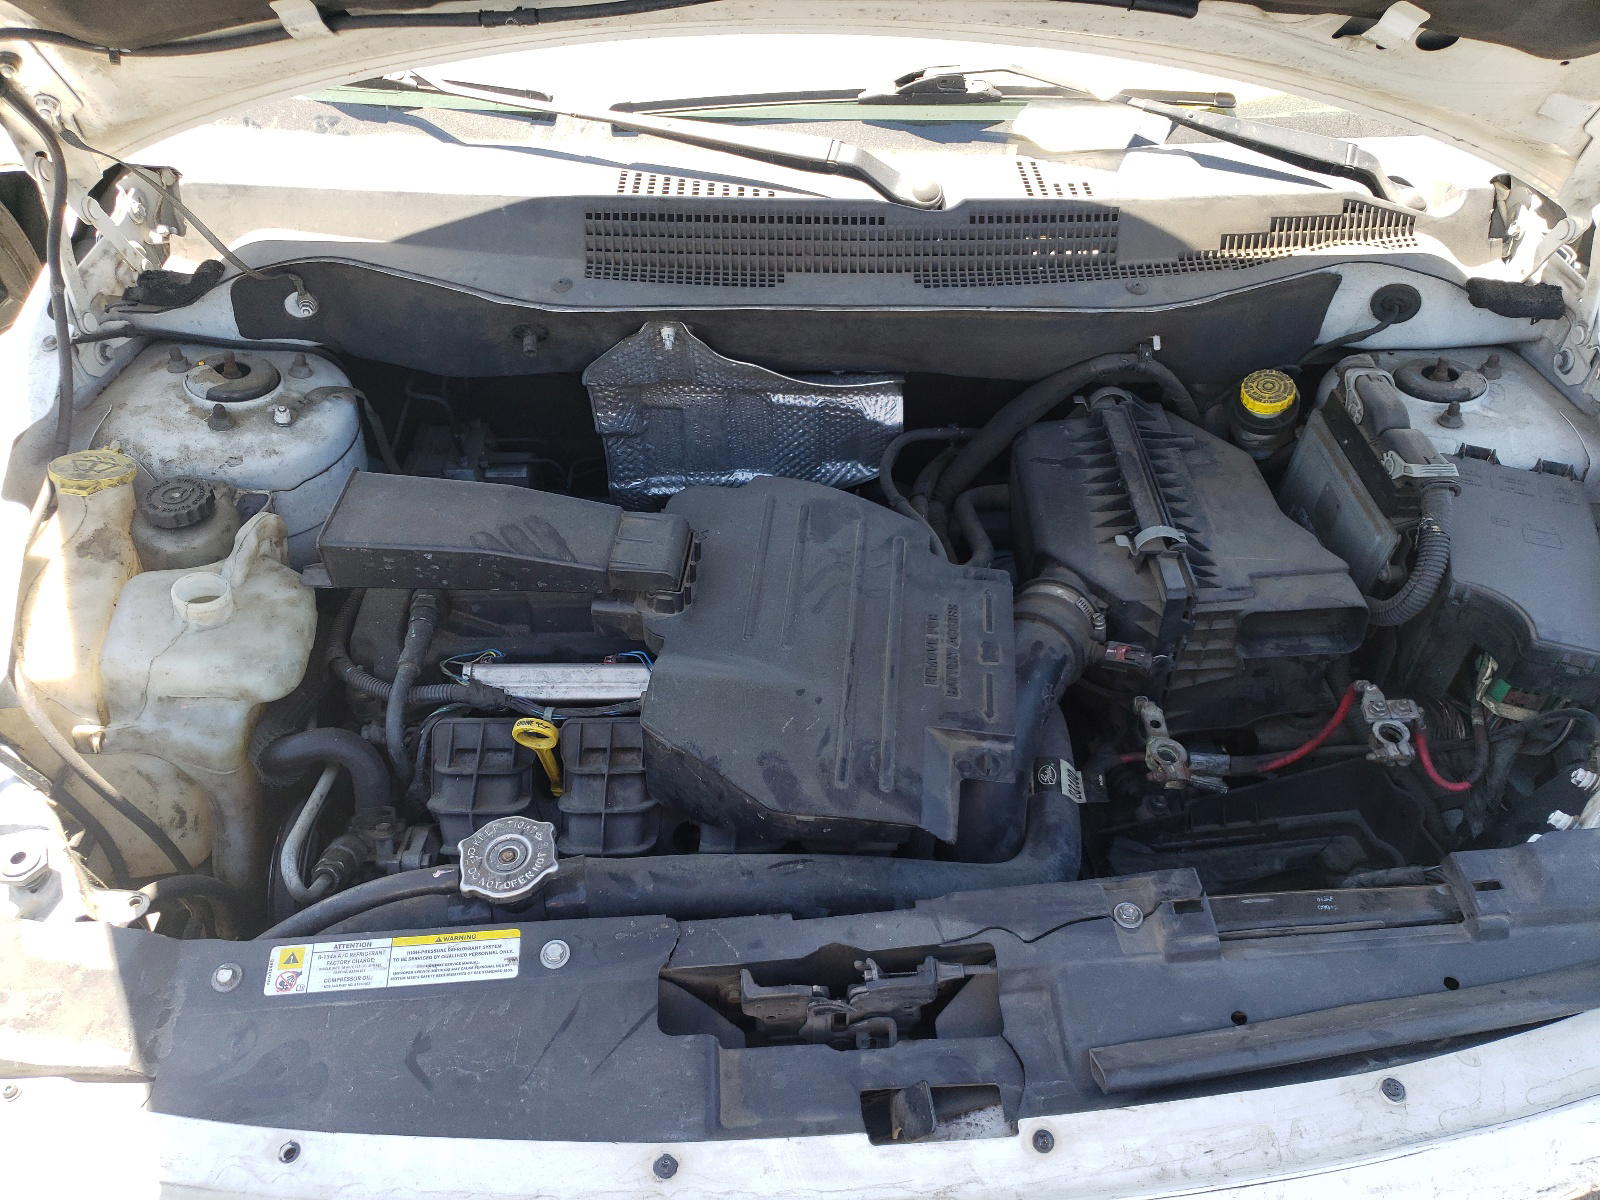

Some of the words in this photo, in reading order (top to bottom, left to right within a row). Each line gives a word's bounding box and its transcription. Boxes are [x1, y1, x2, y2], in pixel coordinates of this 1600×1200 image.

[501, 870, 535, 889] OPEN
[532, 851, 548, 872] HOT
[333, 941, 373, 950] ATTENTION
[349, 949, 387, 959] REFRIGERANT
[323, 975, 362, 984] COMPRESSOR
